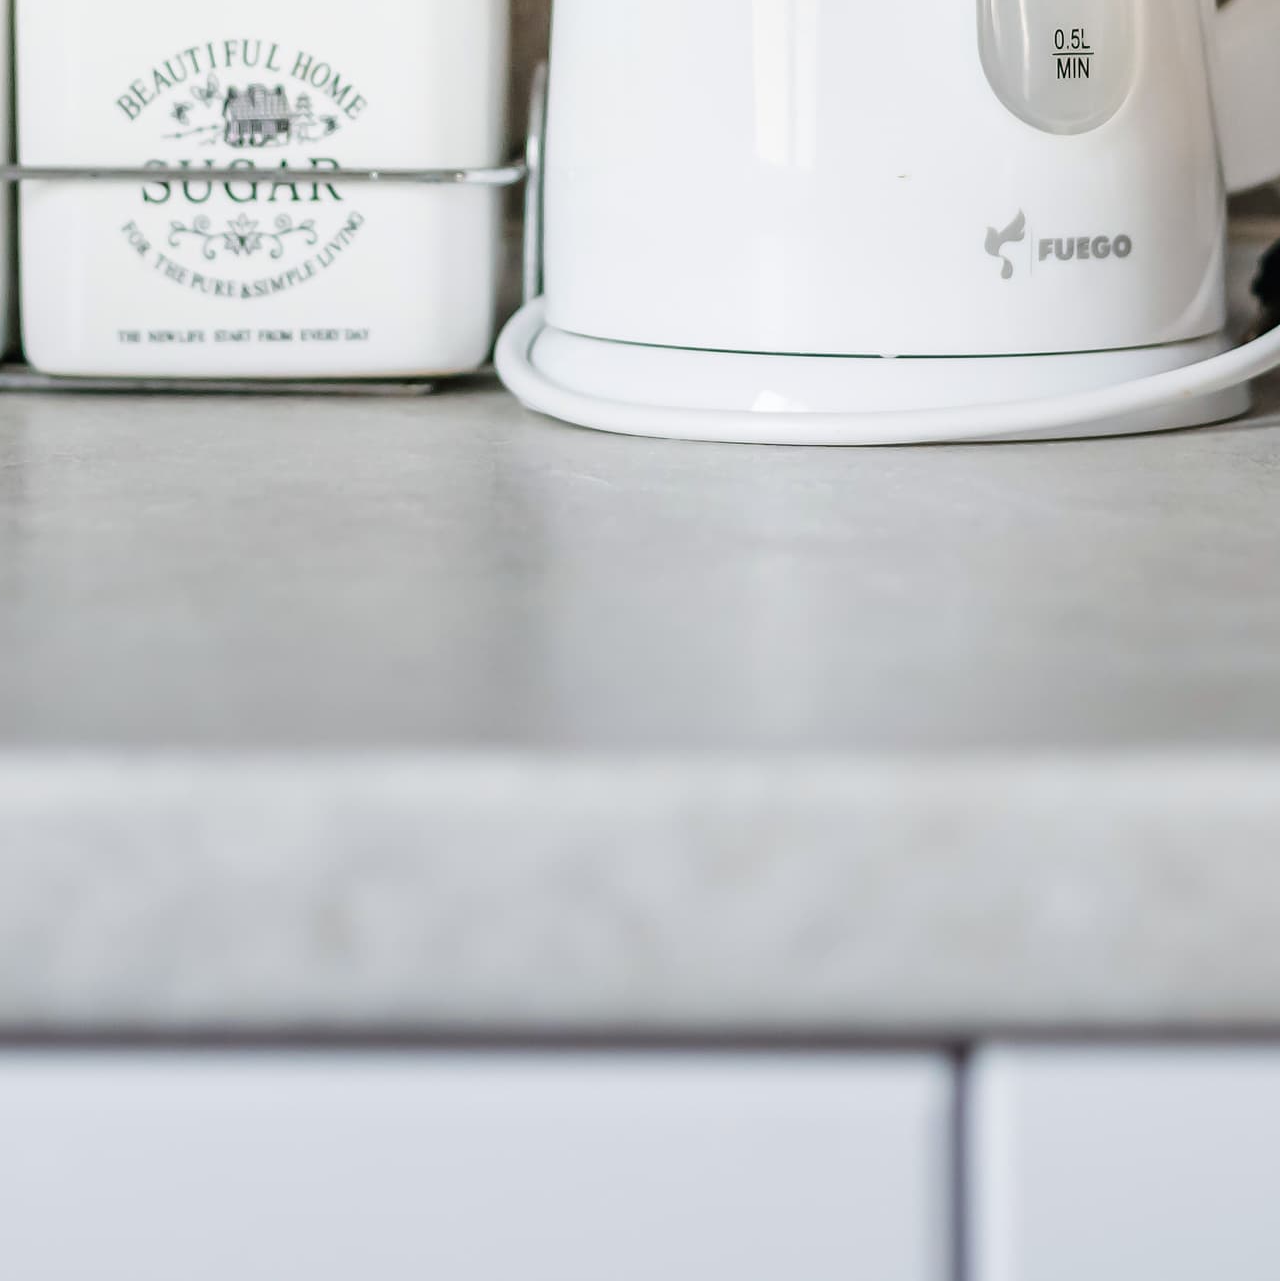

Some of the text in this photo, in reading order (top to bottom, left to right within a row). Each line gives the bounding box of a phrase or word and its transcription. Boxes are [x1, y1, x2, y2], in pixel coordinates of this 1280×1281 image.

[1054, 28, 1091, 51] 0.5L
[115, 38, 369, 121] BEAUTIFUL HOME
[1056, 57, 1090, 80] MIN
[142, 157, 343, 204] SUGAR
[121, 219, 151, 257] FOR
[154, 253, 187, 284] THE
[190, 273, 233, 297] PURE
[253, 259, 317, 297] SIMPLE
[316, 210, 366, 268] LIVING
[1038, 234, 1132, 262] FUEGO
